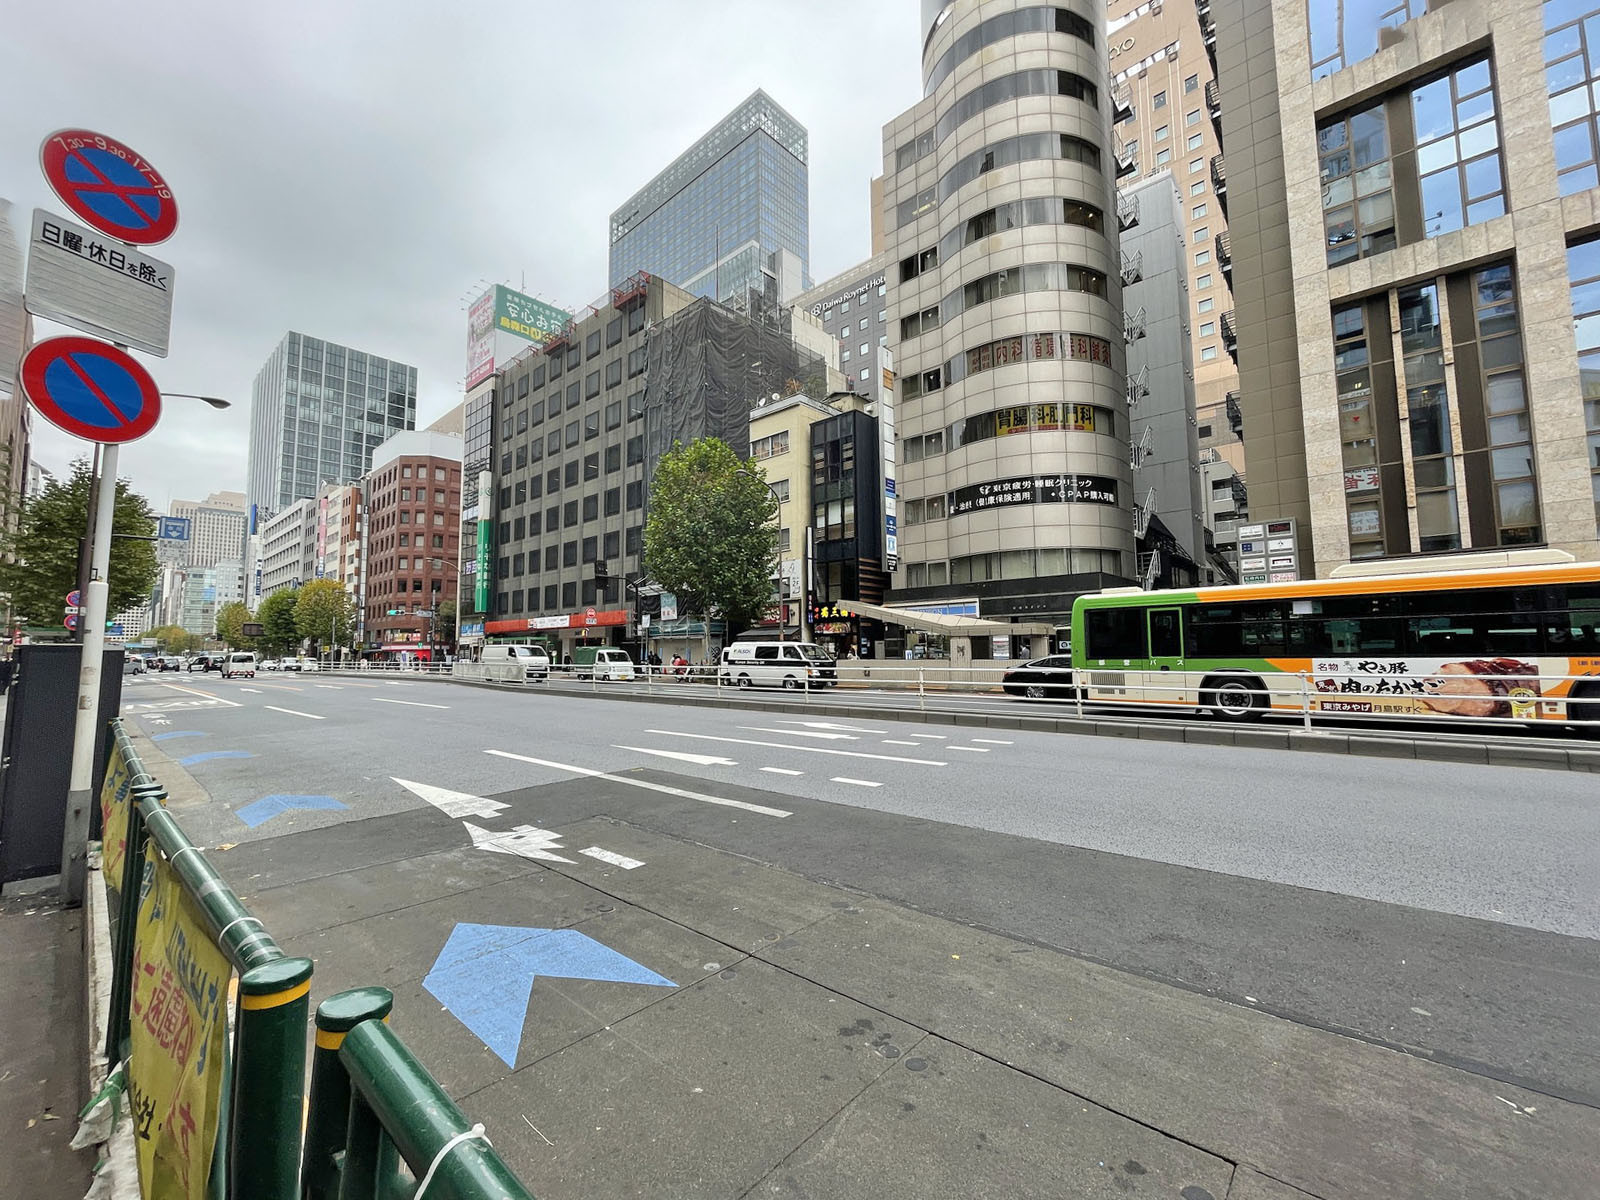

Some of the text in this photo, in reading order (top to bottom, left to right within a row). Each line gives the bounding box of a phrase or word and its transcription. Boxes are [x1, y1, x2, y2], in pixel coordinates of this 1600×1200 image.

[42, 221, 167, 289] 日曜・休日を除く
[822, 296, 842, 311] Daiwa
[843, 282, 869, 302] Roynet
[1317, 662, 1339, 672] 名物
[1322, 702, 1371, 712] 東京みやげ
